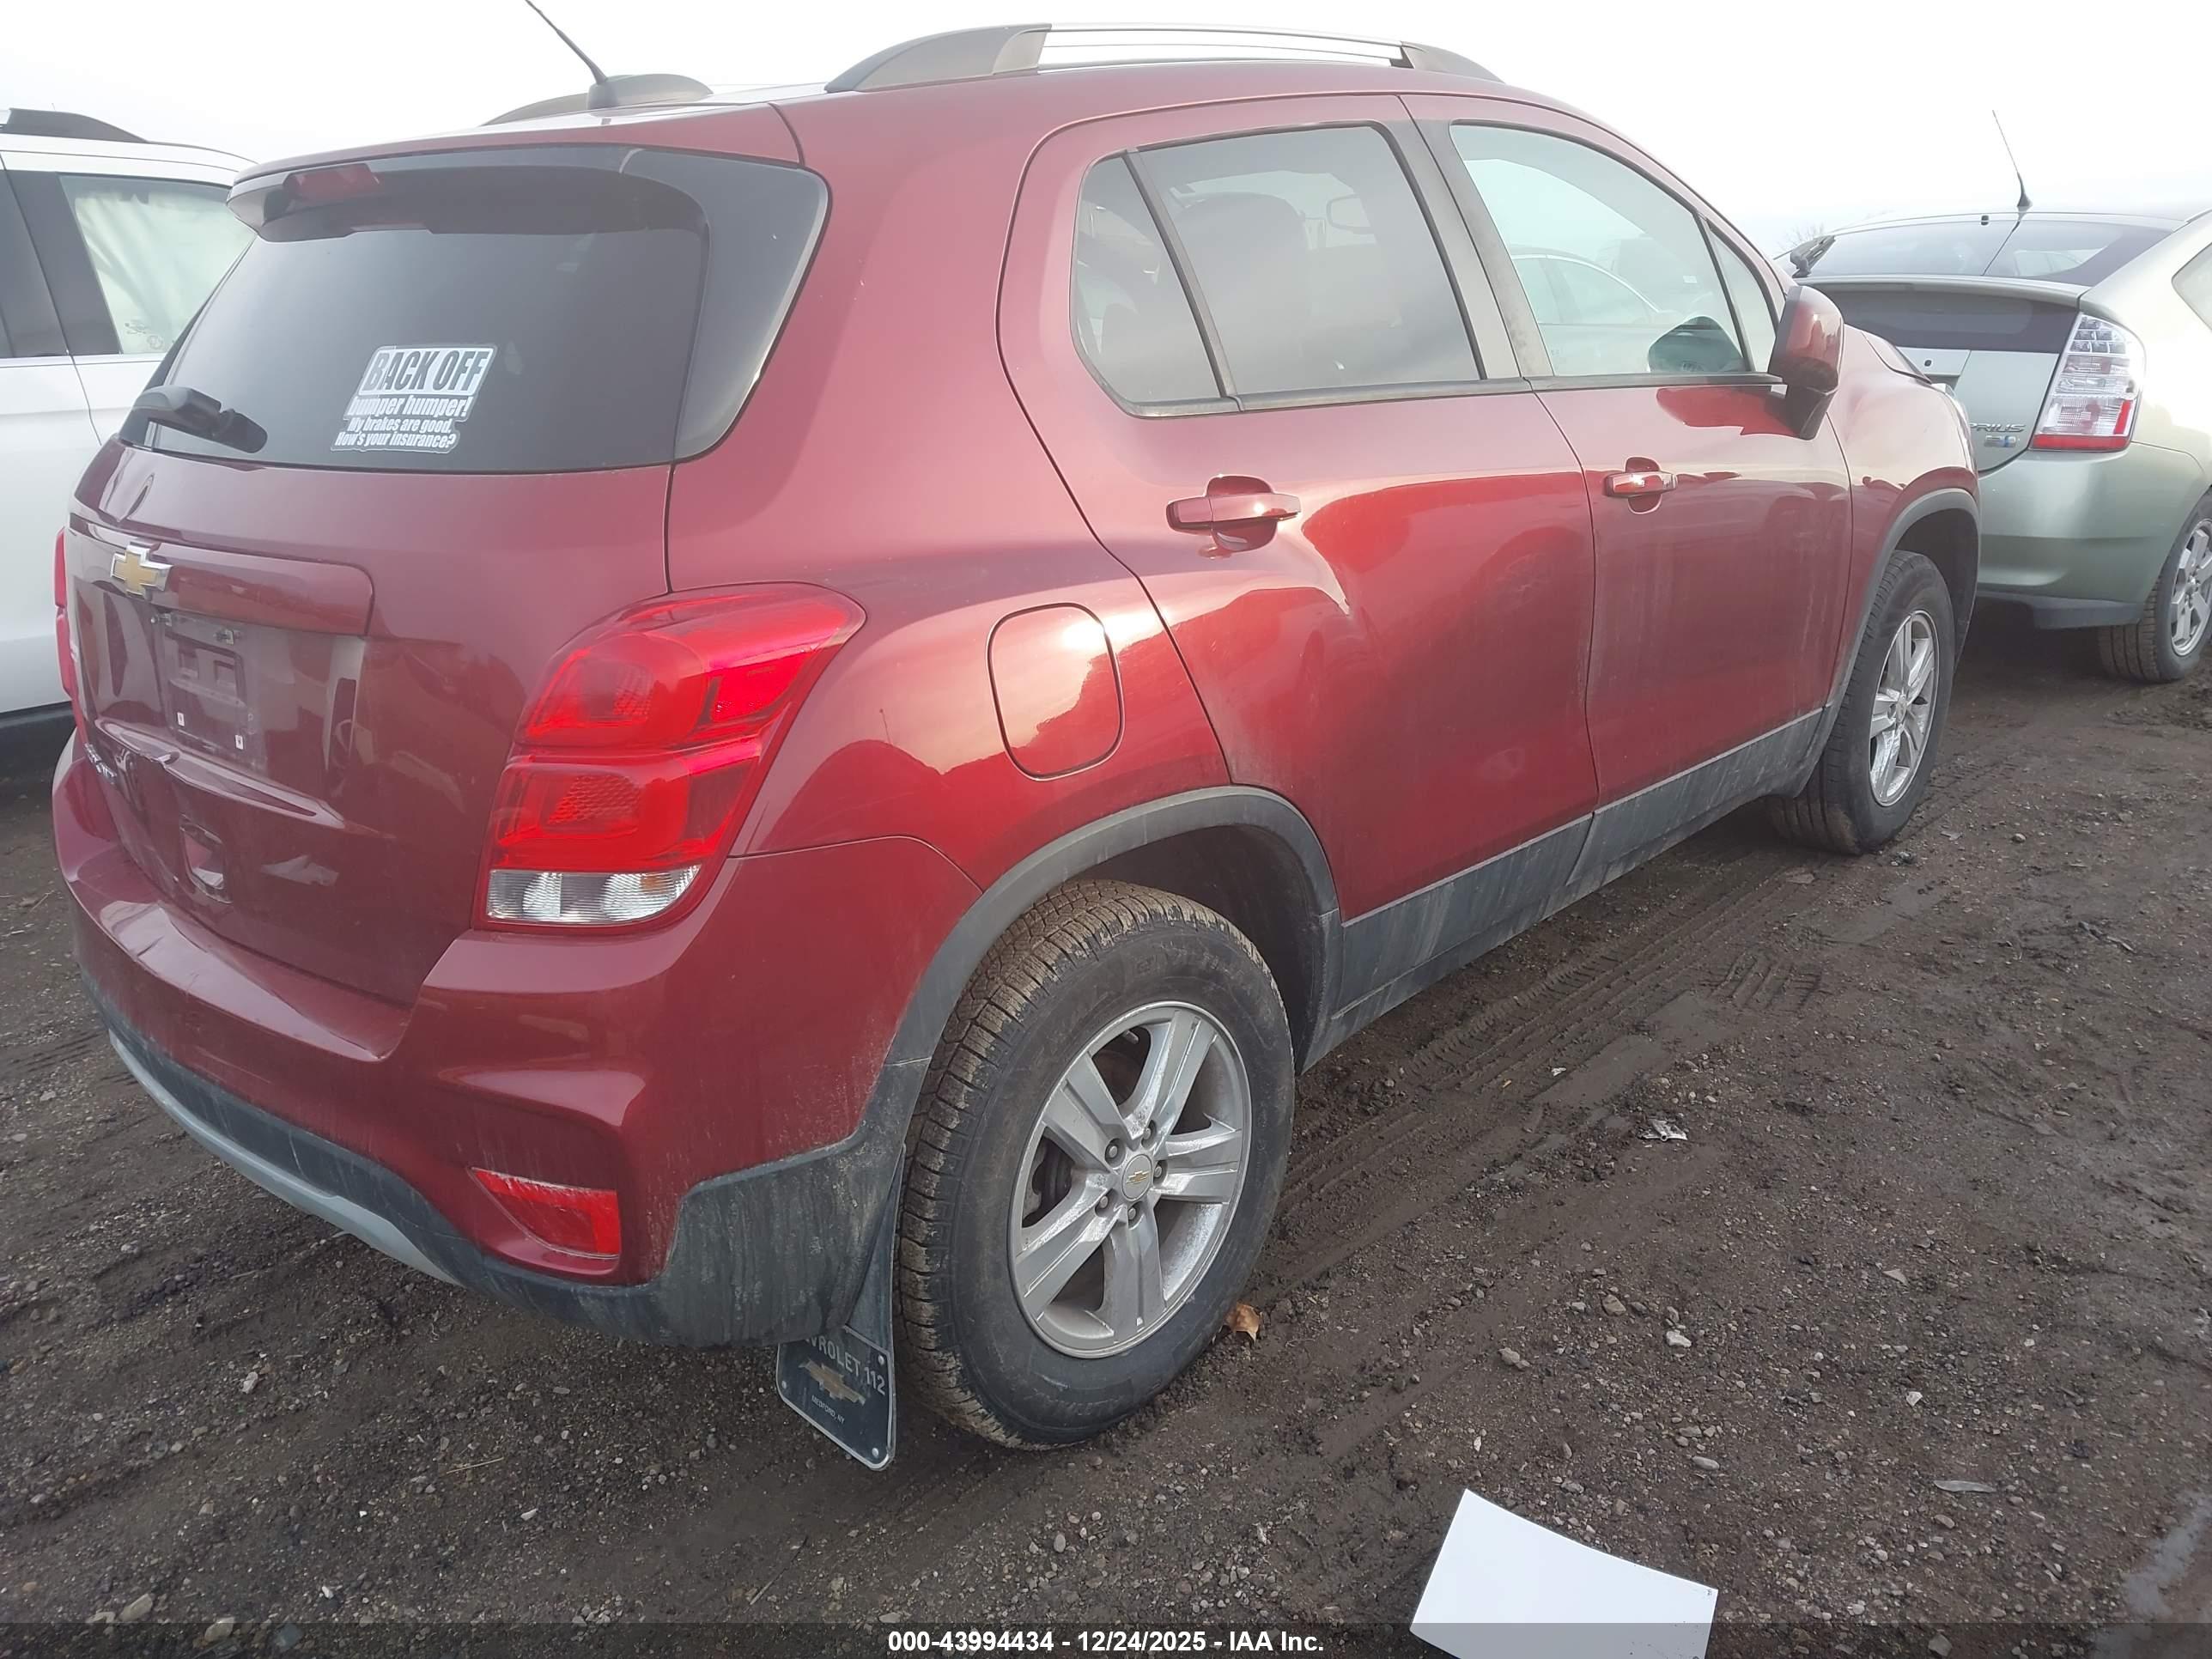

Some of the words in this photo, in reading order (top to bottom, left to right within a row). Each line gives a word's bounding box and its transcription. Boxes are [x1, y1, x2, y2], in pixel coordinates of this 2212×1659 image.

[362, 350, 440, 391] BACK
[433, 350, 489, 391] OFF
[347, 396, 405, 417] bumper
[402, 395, 473, 417] humper!
[347, 417, 367, 432] My
[366, 416, 401, 431] brakes
[400, 419, 421, 431] are
[420, 418, 453, 434] good.
[1968, 422, 2026, 433] PRIUS
[335, 432, 367, 446] How's
[364, 434, 391, 447] your
[389, 432, 457, 448] insurance?
[810, 1335, 860, 1377] VROLET
[864, 1366, 885, 1395] 112
